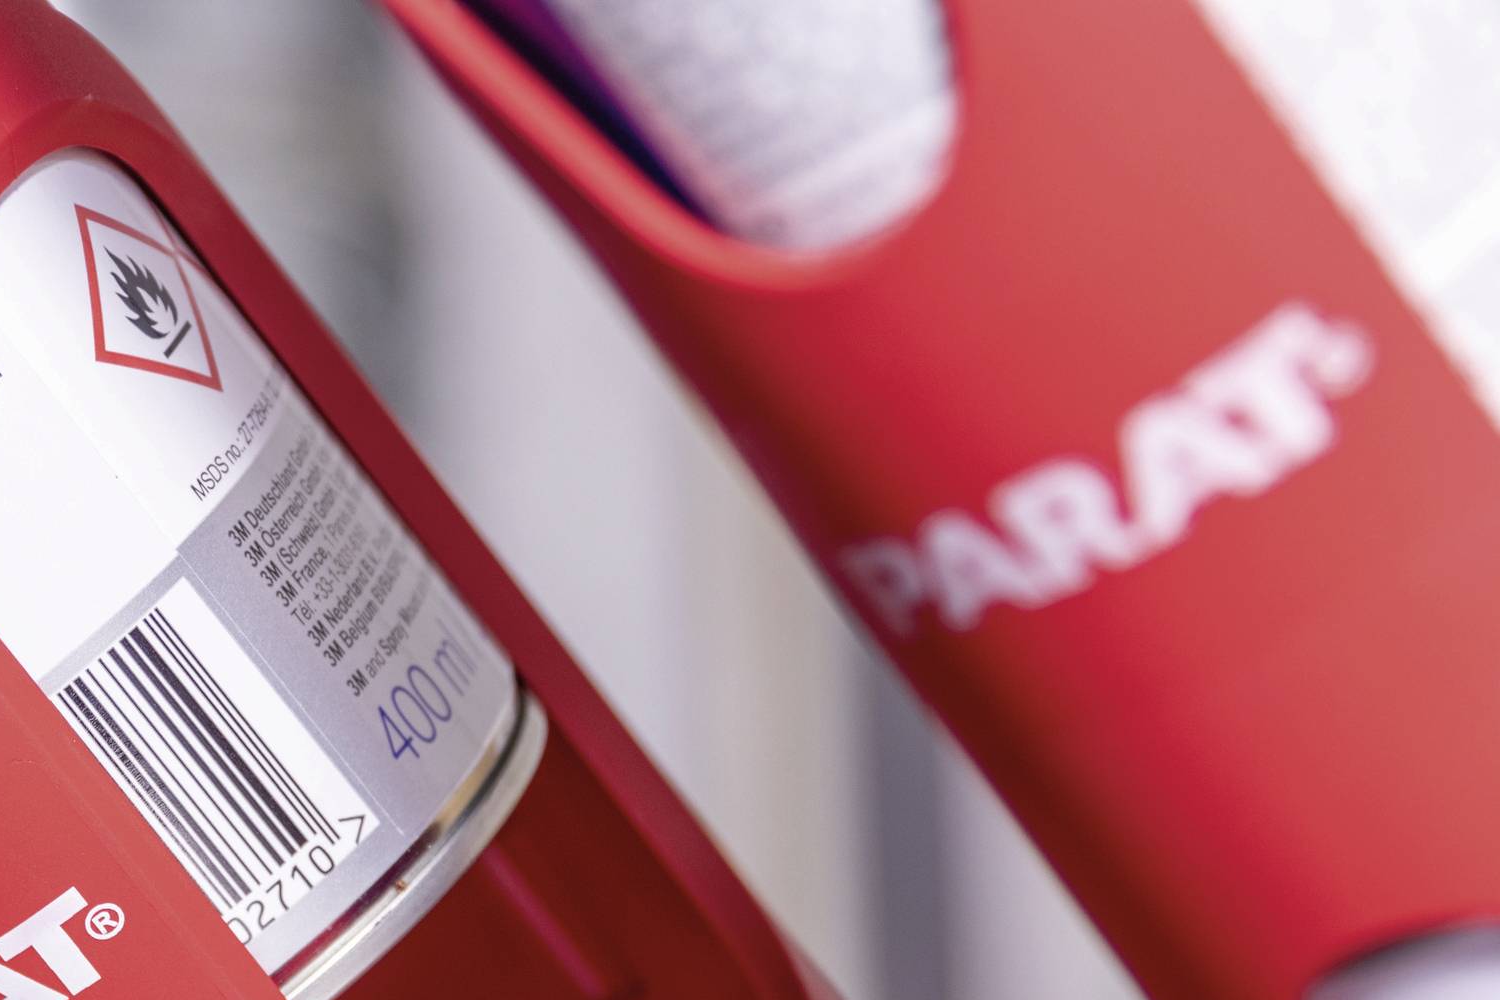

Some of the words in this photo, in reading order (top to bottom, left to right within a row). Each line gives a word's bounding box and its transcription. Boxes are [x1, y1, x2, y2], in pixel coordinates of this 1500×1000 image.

[190, 455, 230, 501] MSDS
[228, 520, 251, 548] 3M
[243, 460, 298, 529] Deutschland
[244, 541, 267, 568] 3M
[257, 484, 304, 549] Österreich
[260, 560, 283, 588] 3M
[276, 513, 322, 573] (Schweiz)
[276, 580, 299, 608] 3M
[291, 546, 332, 590] France,
[307, 620, 330, 647] 3M
[323, 571, 371, 629] Nederland
[323, 639, 346, 667] 3M
[338, 599, 379, 649] Belgium
[346, 668, 369, 698] 3M
[365, 650, 387, 679] and
[378, 623, 410, 657] Spray
[378, 664, 452, 760] 400
